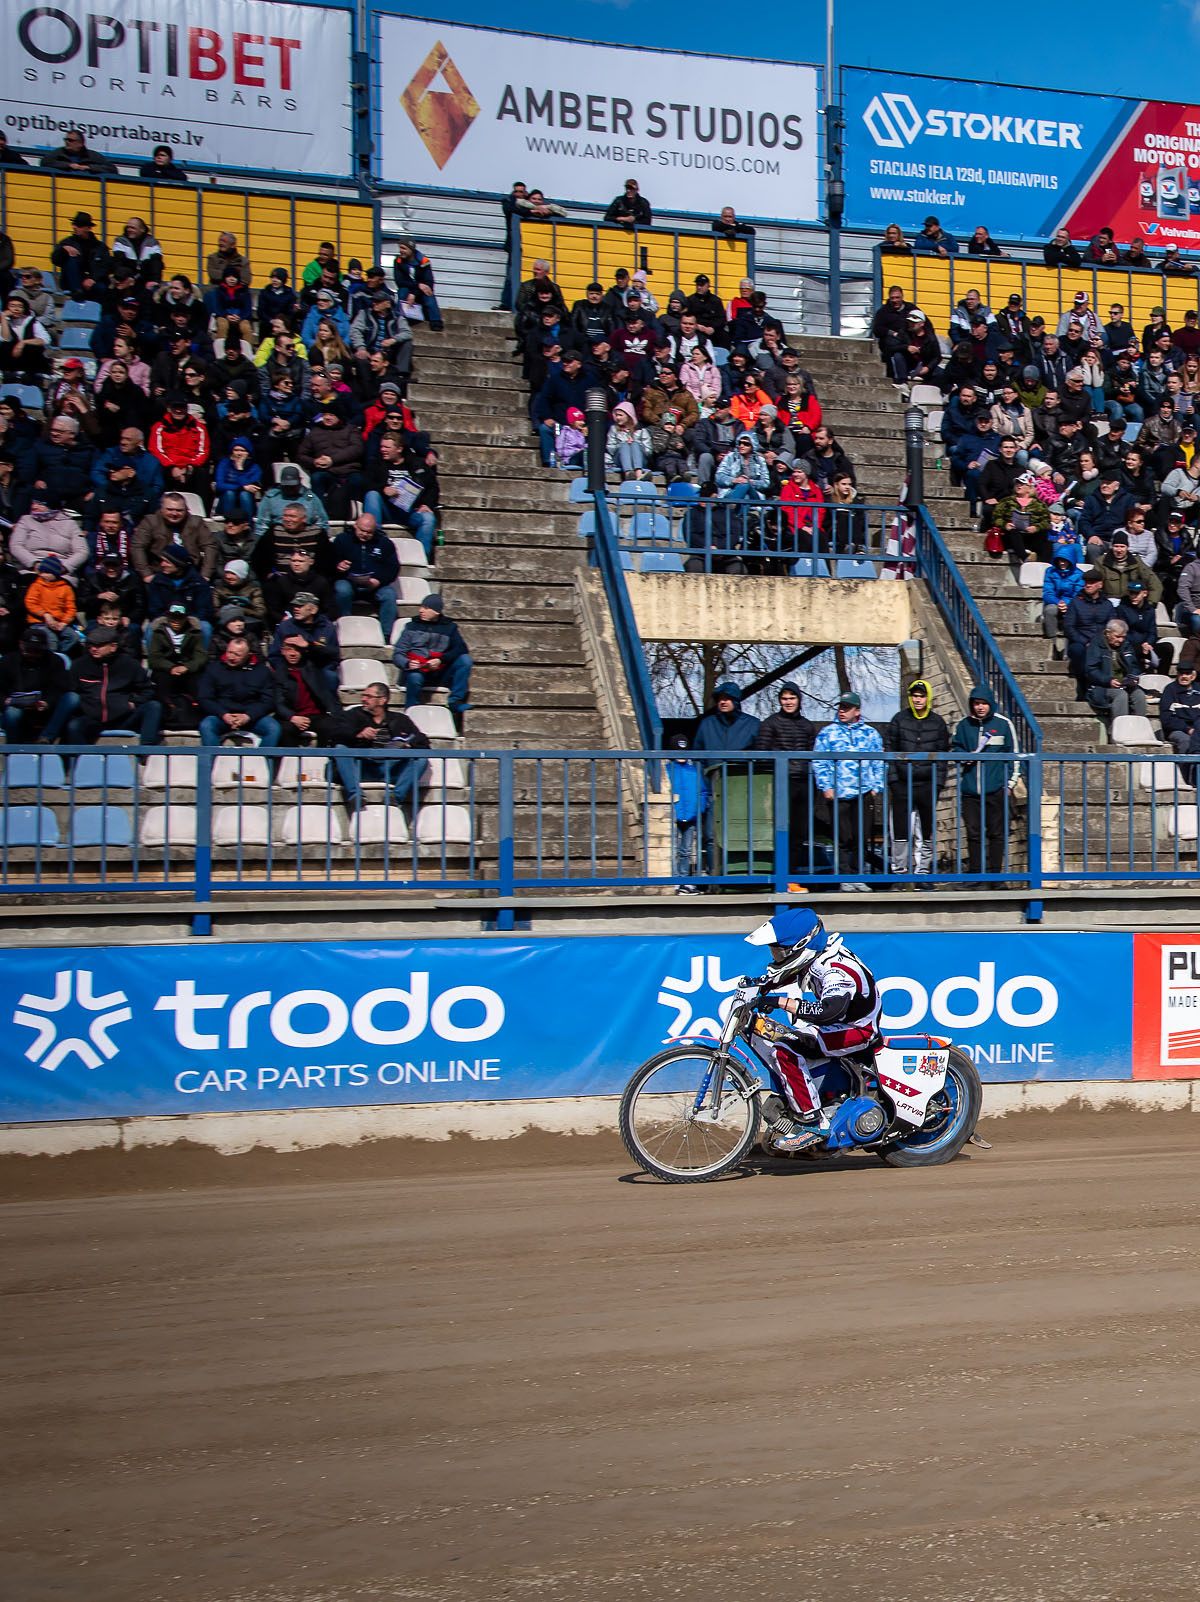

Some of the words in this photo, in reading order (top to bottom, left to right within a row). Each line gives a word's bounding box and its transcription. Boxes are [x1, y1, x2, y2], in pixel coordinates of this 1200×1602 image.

[18, 7, 301, 91] OPTIBET
[24, 67, 177, 98] SPORTA
[205, 89, 298, 111] BĀRS
[5, 112, 204, 147] optibetsportabars.lv
[496, 84, 635, 136] AMBER
[646, 101, 803, 150] STUDIOS
[923, 109, 1083, 150] STOKKER
[525, 136, 781, 175] WWW.AMBER-STUDIOS.COM
[1133, 148, 1186, 167] MOTOR
[870, 158, 926, 179] STACIJAS
[928, 164, 953, 181] IELA
[956, 166, 986, 185] 129d,
[988, 170, 1058, 190] DAUGAVPILS
[870, 186, 965, 206] www.stokker.lv
[153, 971, 506, 1050] trodo
[1168, 996, 1199, 1008] MADE
[174, 1069, 247, 1094] CAR
[257, 1063, 369, 1090] PARTS
[377, 1059, 501, 1086] ONLINE
[896, 1101, 924, 1117] LATVIA
